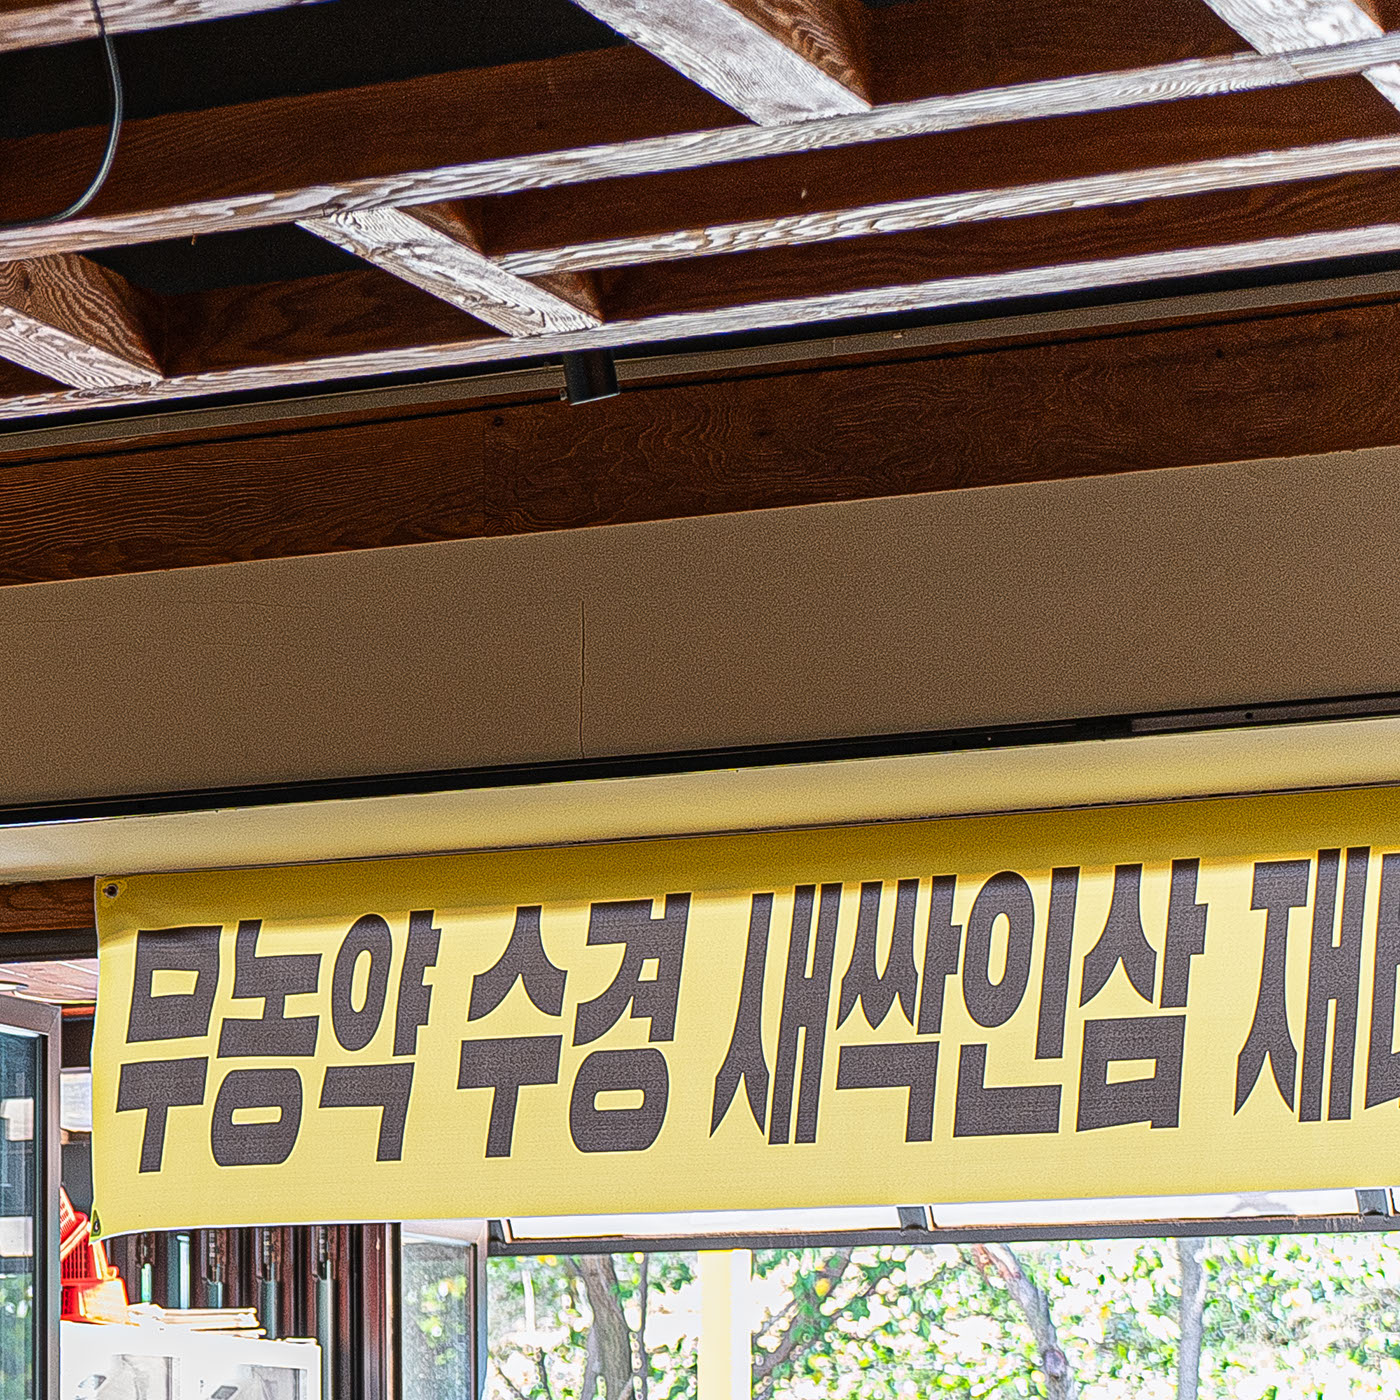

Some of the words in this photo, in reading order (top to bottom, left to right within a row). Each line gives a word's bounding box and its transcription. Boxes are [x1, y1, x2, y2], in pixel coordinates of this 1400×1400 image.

[115, 909, 442, 1174] 무농약
[456, 892, 692, 1159] 수경
[709, 856, 1210, 1146] 새싹인삼
